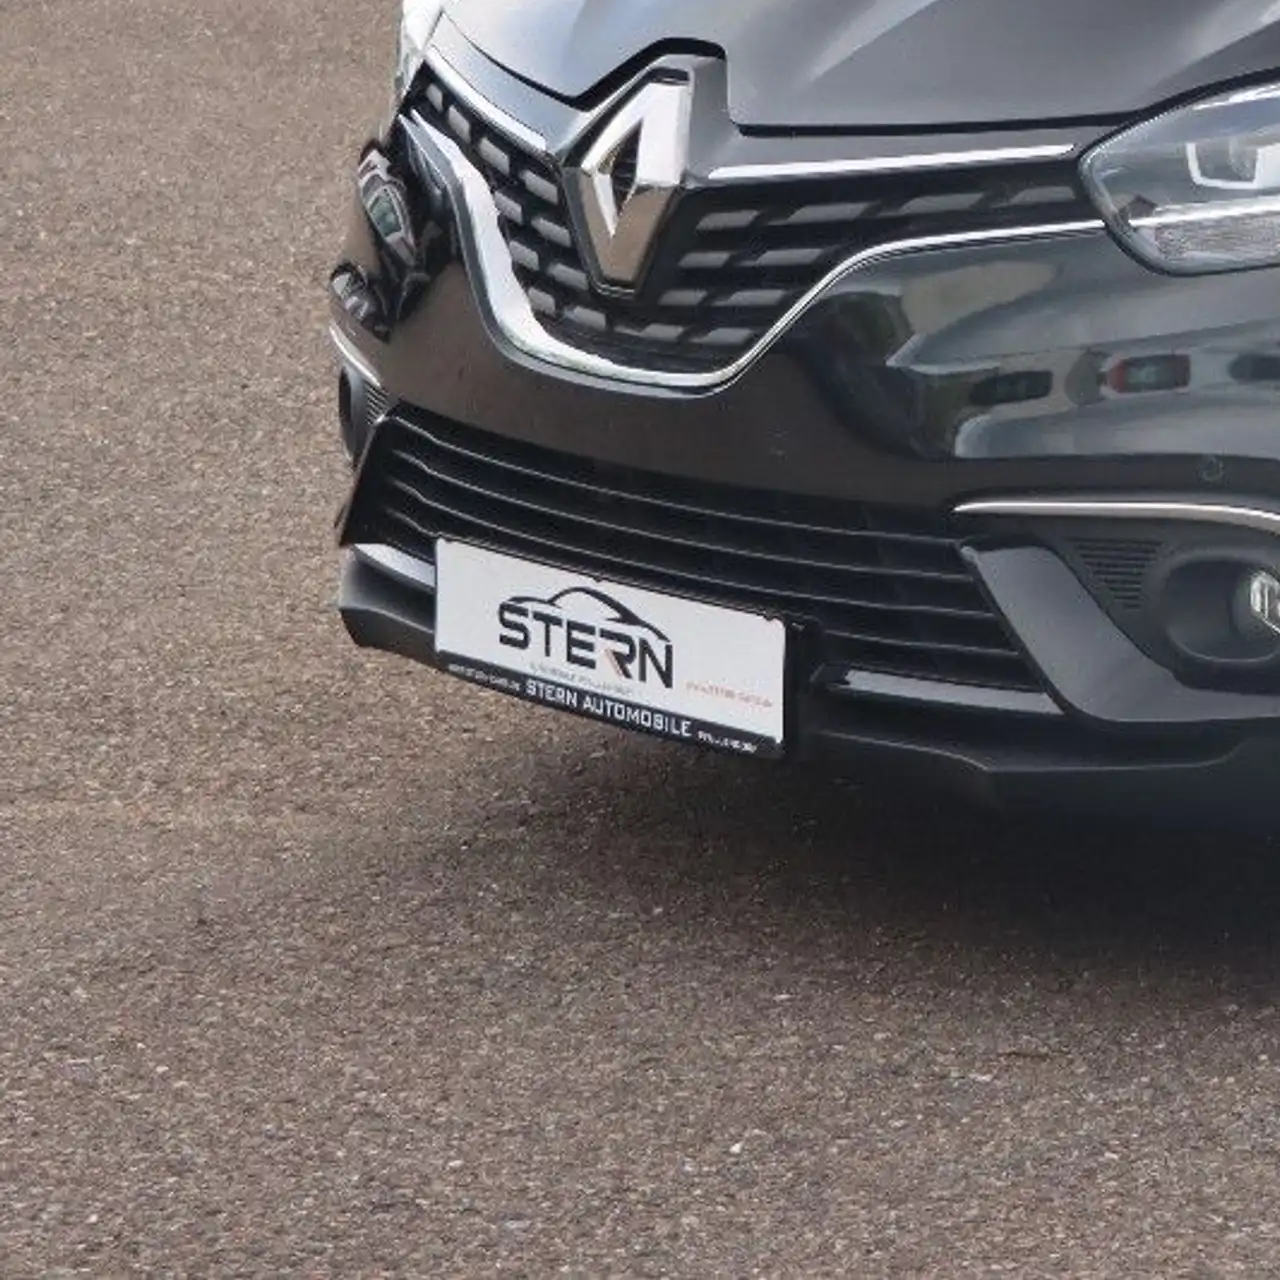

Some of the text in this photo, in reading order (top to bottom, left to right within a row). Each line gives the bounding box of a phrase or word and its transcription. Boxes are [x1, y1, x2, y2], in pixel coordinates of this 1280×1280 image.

[498, 600, 673, 689] STERN
[525, 680, 692, 738] STERN AUTOMOBILE
